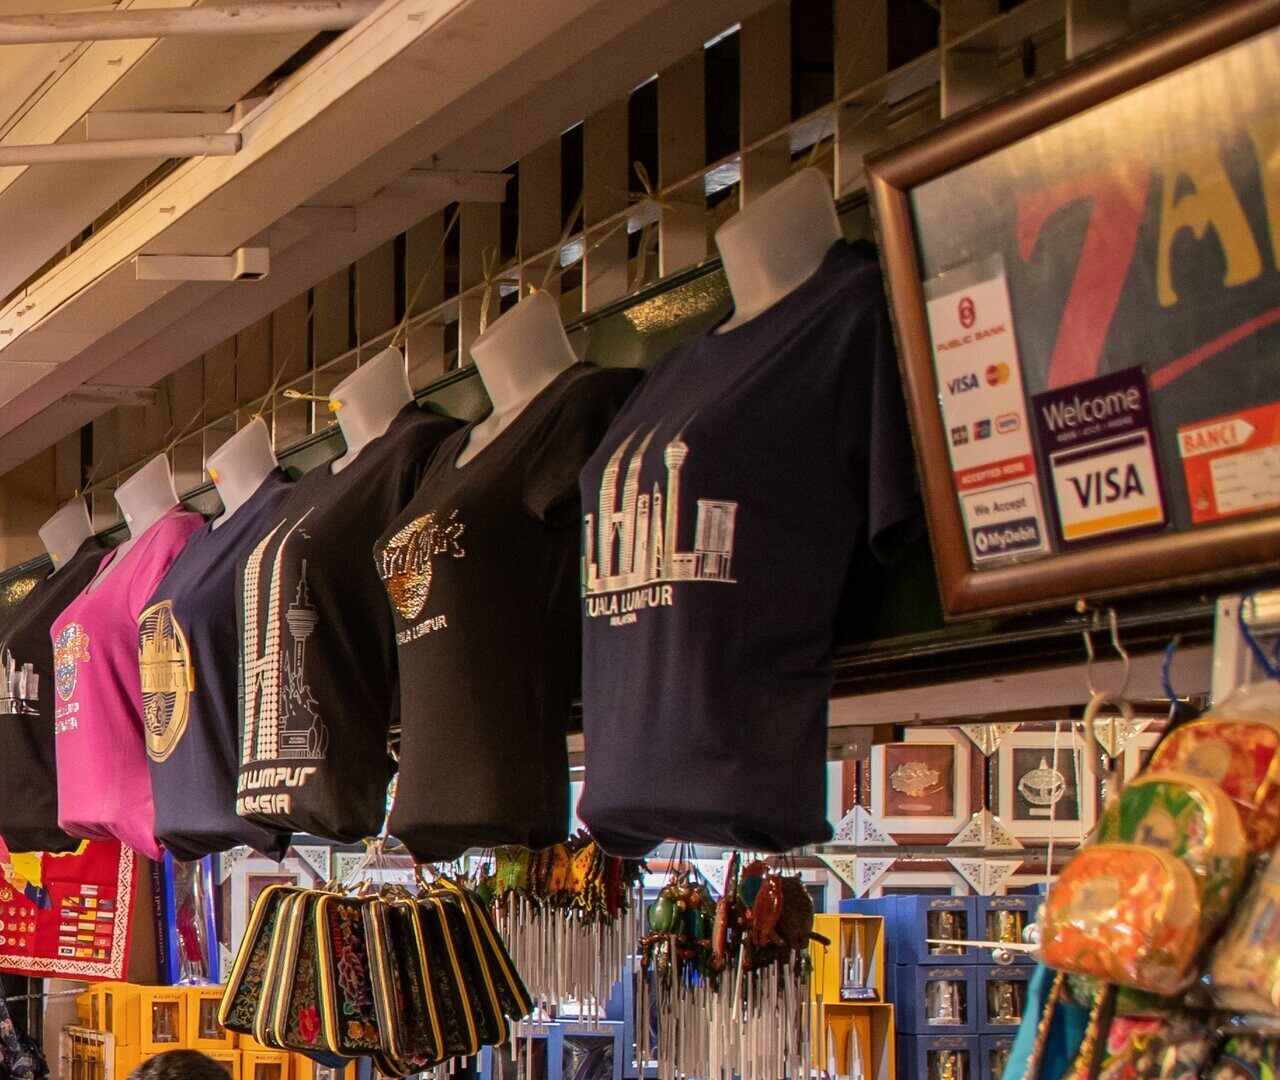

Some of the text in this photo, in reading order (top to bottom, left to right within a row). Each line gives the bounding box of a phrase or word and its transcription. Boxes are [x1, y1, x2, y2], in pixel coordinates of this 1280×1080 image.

[936, 323, 1006, 352] PUBLIC BANK
[947, 373, 980, 395] VISA
[1042, 385, 1140, 431] Welcome
[1065, 463, 1144, 508] VISA
[973, 497, 1027, 516] We Accept
[621, 583, 674, 612] LUMPUR
